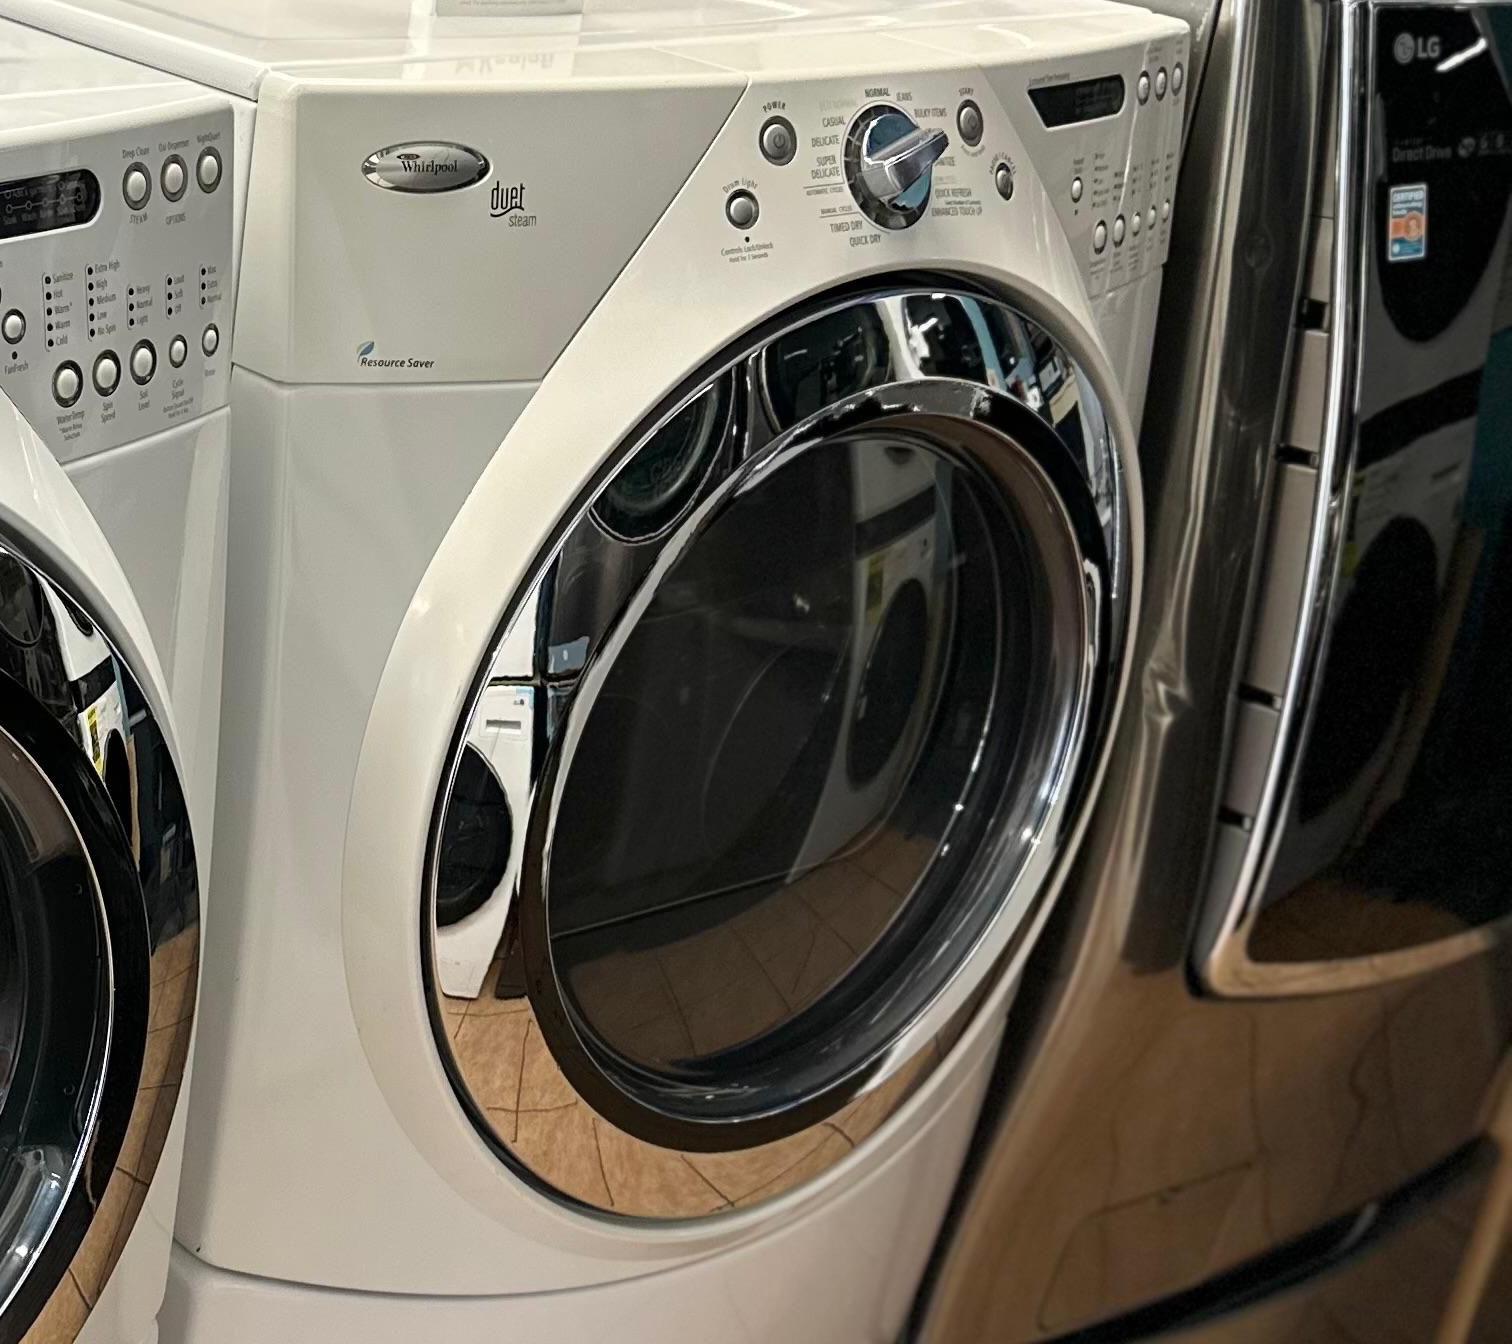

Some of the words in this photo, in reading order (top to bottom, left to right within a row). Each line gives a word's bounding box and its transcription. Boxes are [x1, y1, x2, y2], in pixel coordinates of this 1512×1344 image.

[1416, 35, 1441, 58] LG
[864, 87, 891, 98] NORMAL
[762, 100, 786, 113] POWER
[811, 136, 841, 148] DELICATE
[401, 159, 458, 175] Whirlpool
[811, 166, 841, 180] DELICATE
[490, 180, 526, 212] duet
[508, 213, 537, 228] steam
[360, 356, 405, 369] Resource
[407, 357, 435, 369] Saver
